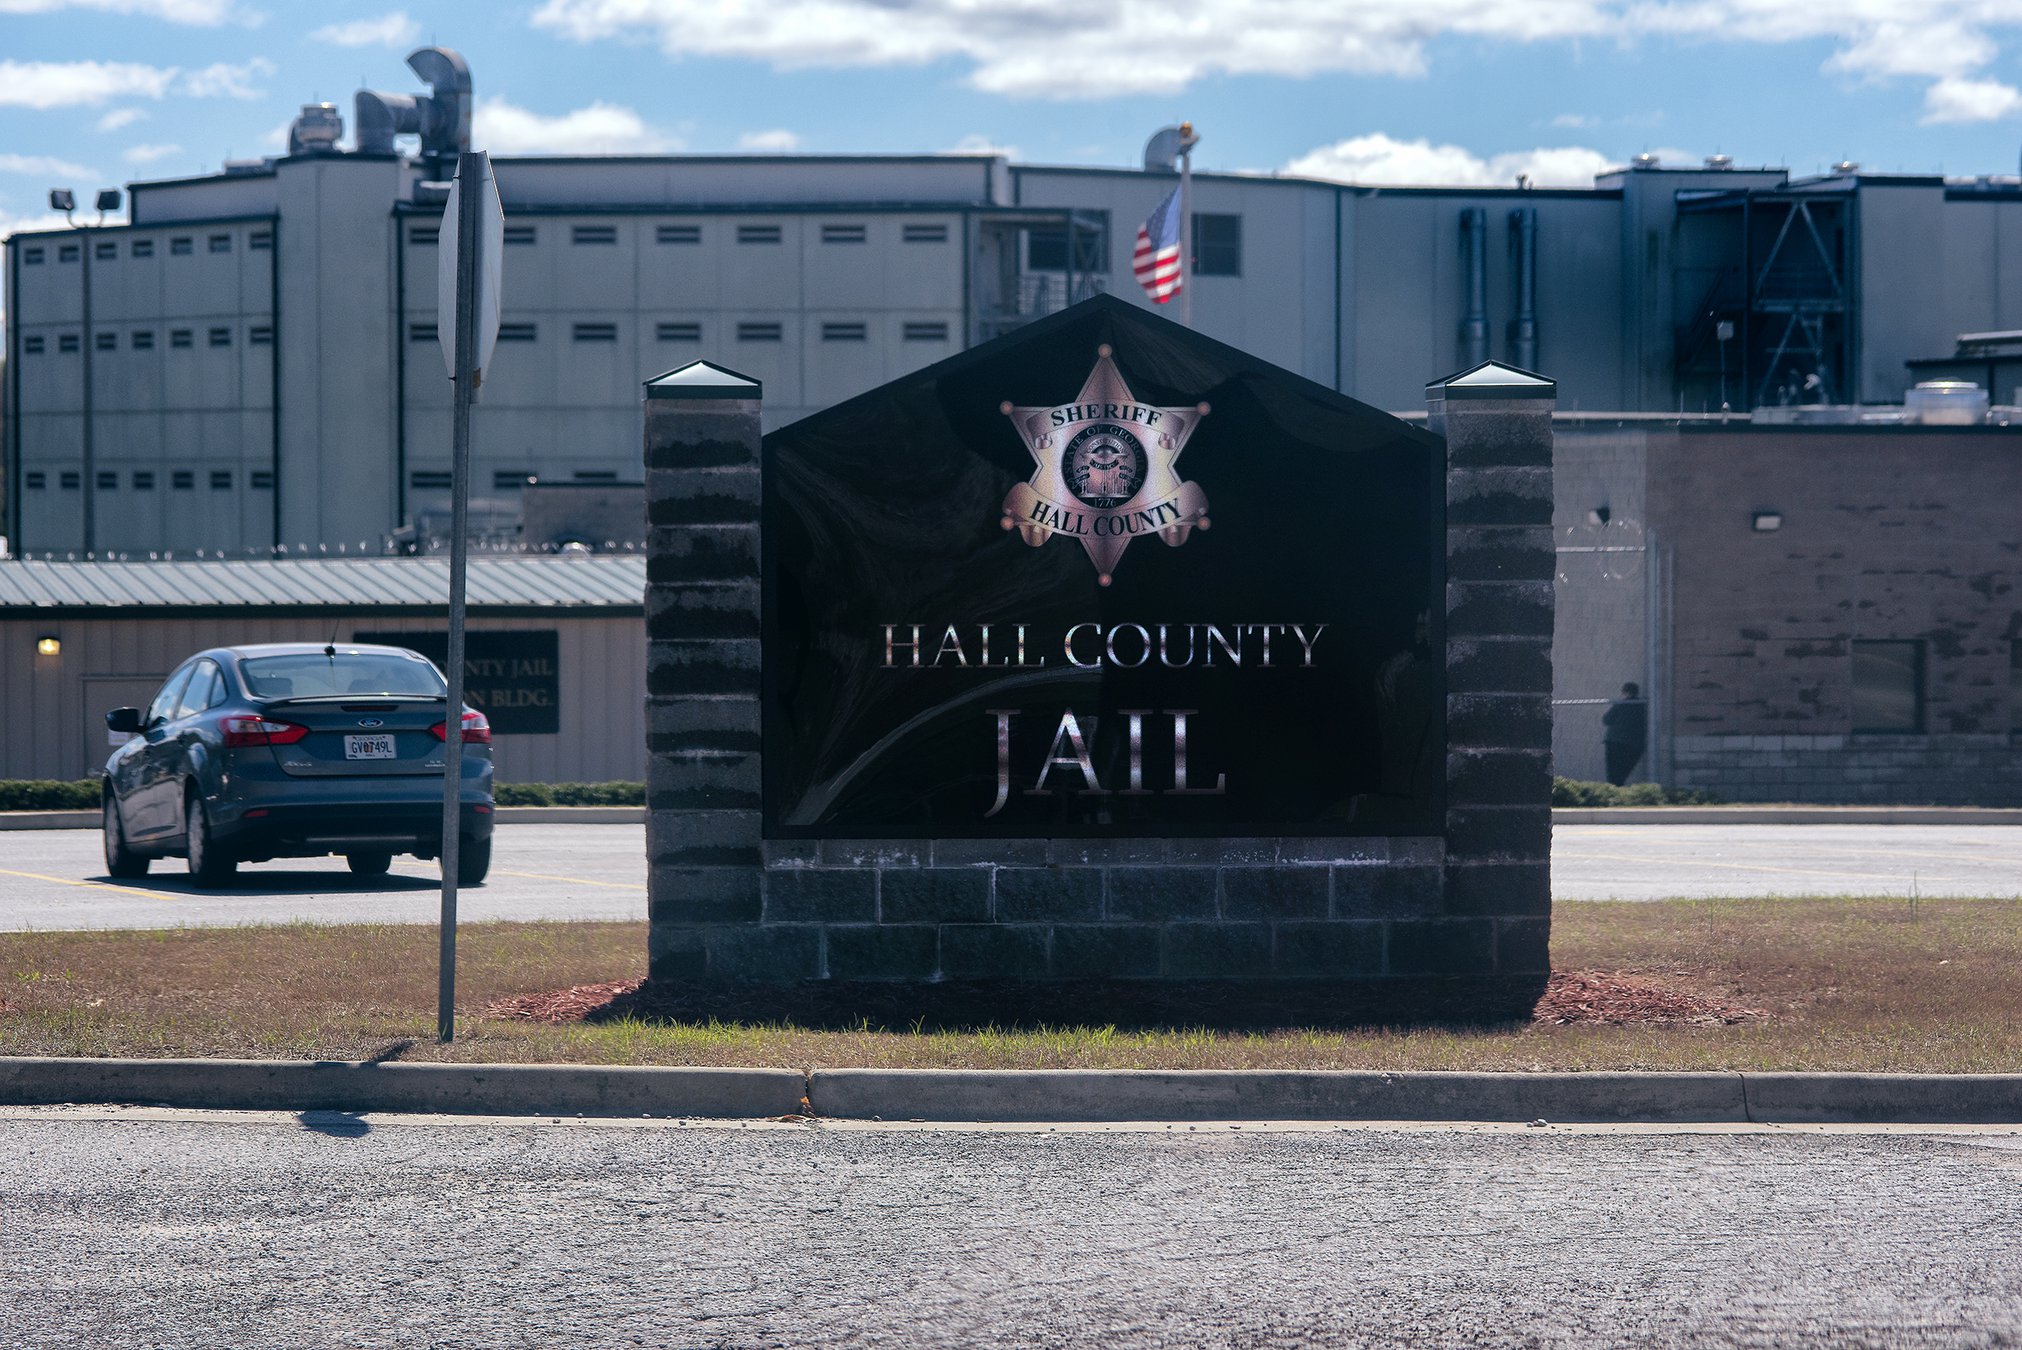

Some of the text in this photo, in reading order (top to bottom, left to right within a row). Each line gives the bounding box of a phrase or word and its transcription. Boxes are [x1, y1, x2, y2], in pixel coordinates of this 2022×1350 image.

[1051, 404, 1162, 426] SHERIFF
[1094, 498, 1116, 507] 1776
[1030, 498, 1182, 536] HALL COUNTY
[879, 622, 1330, 670] HALL COUNTY
[512, 658, 553, 678] JAIL
[491, 688, 554, 707] BLDG.
[984, 706, 1226, 818] JAIL
